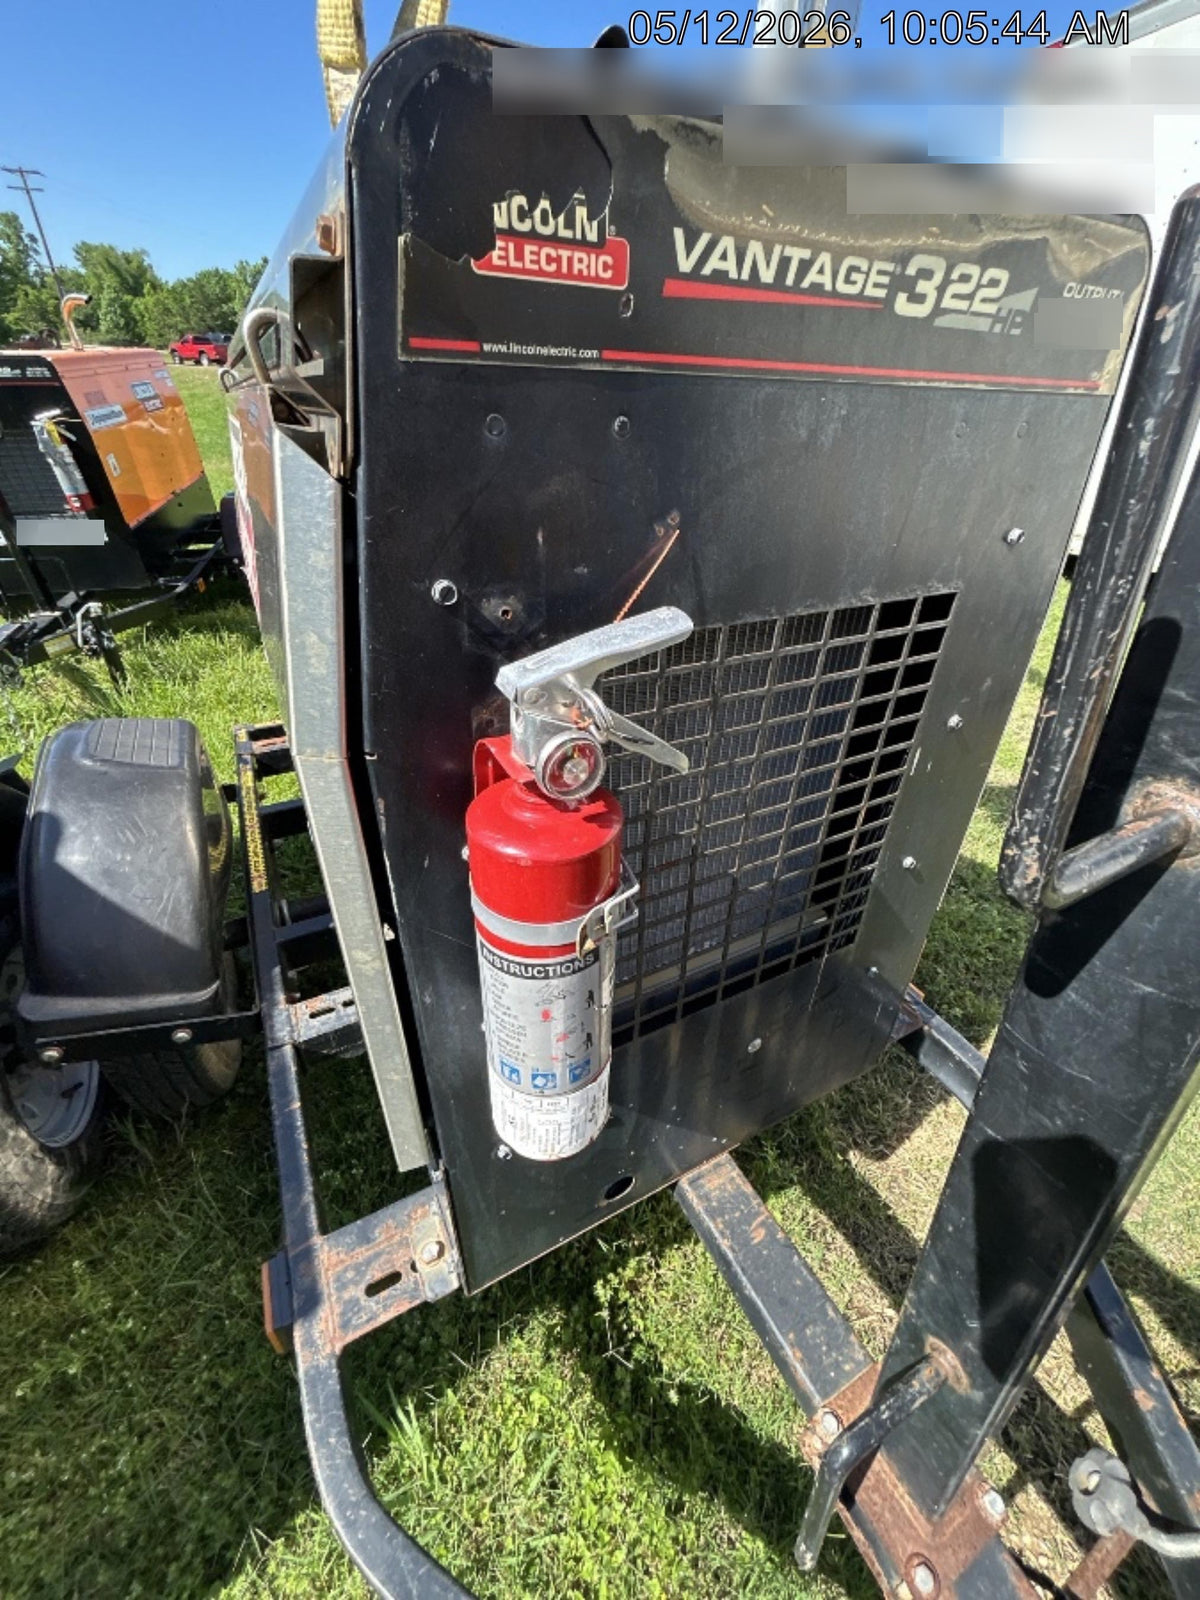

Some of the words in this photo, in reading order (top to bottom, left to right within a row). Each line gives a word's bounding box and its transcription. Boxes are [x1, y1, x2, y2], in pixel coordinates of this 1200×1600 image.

[491, 239, 614, 280] ELECTRIC
[672, 226, 895, 299] VANTAGE
[893, 253, 1010, 318] 322
[482, 340, 600, 359] www.lincolnelectric.com
[482, 945, 596, 978] INSTRUCTIONS
